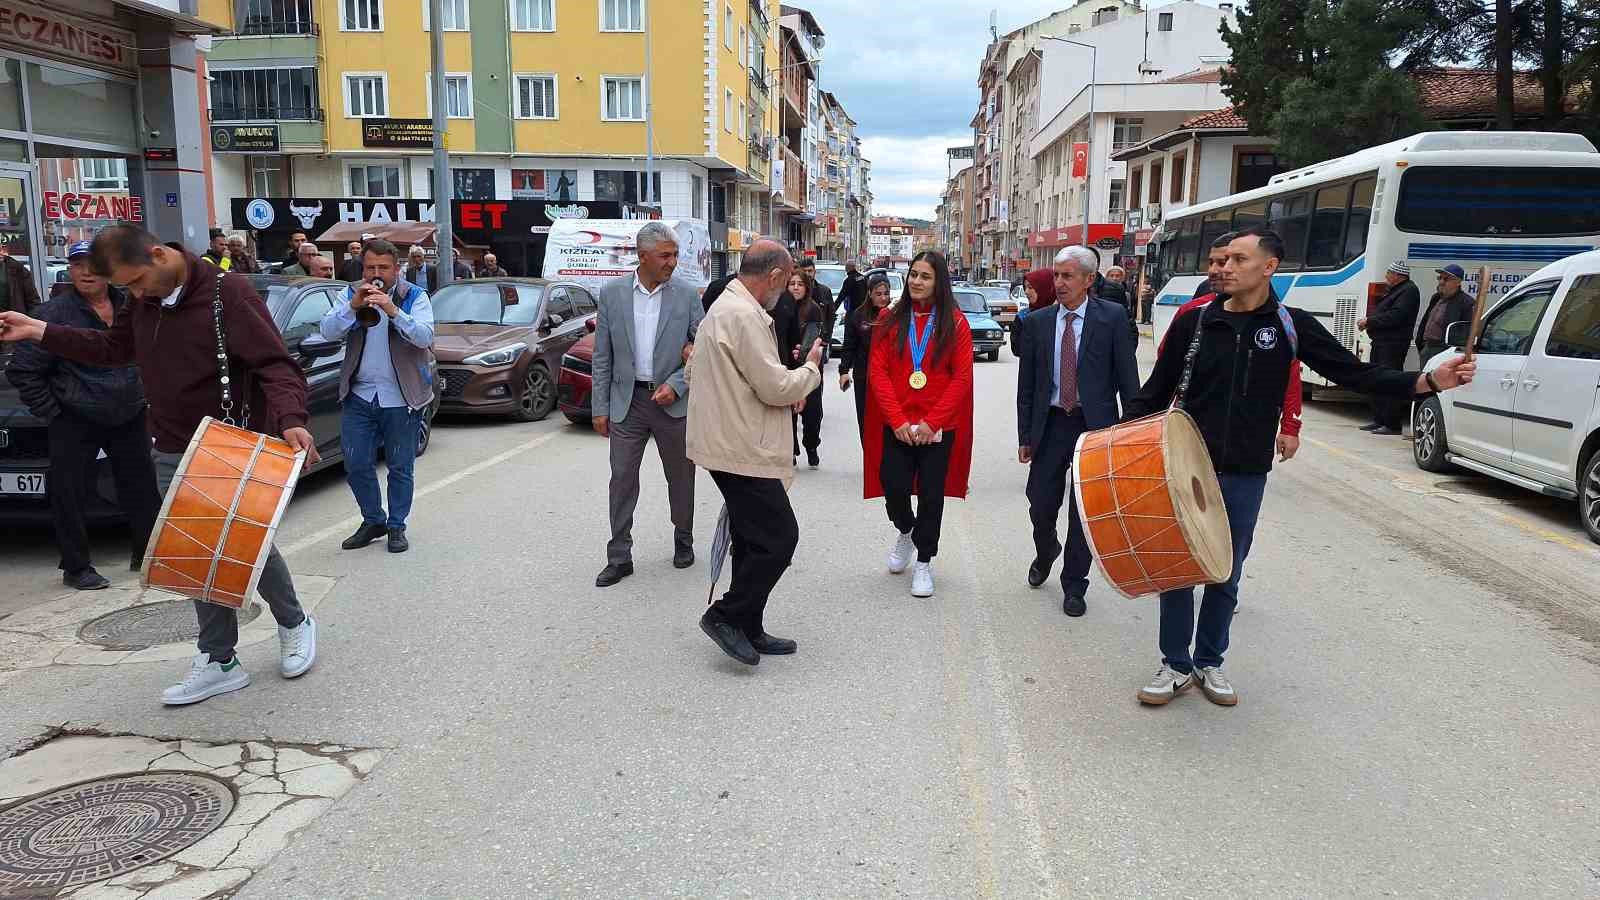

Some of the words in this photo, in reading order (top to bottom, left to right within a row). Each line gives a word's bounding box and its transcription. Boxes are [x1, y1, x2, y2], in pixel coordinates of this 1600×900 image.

[44, 191, 143, 222] ECZANE
[460, 203, 507, 229] ET
[17, 475, 42, 491] 617
